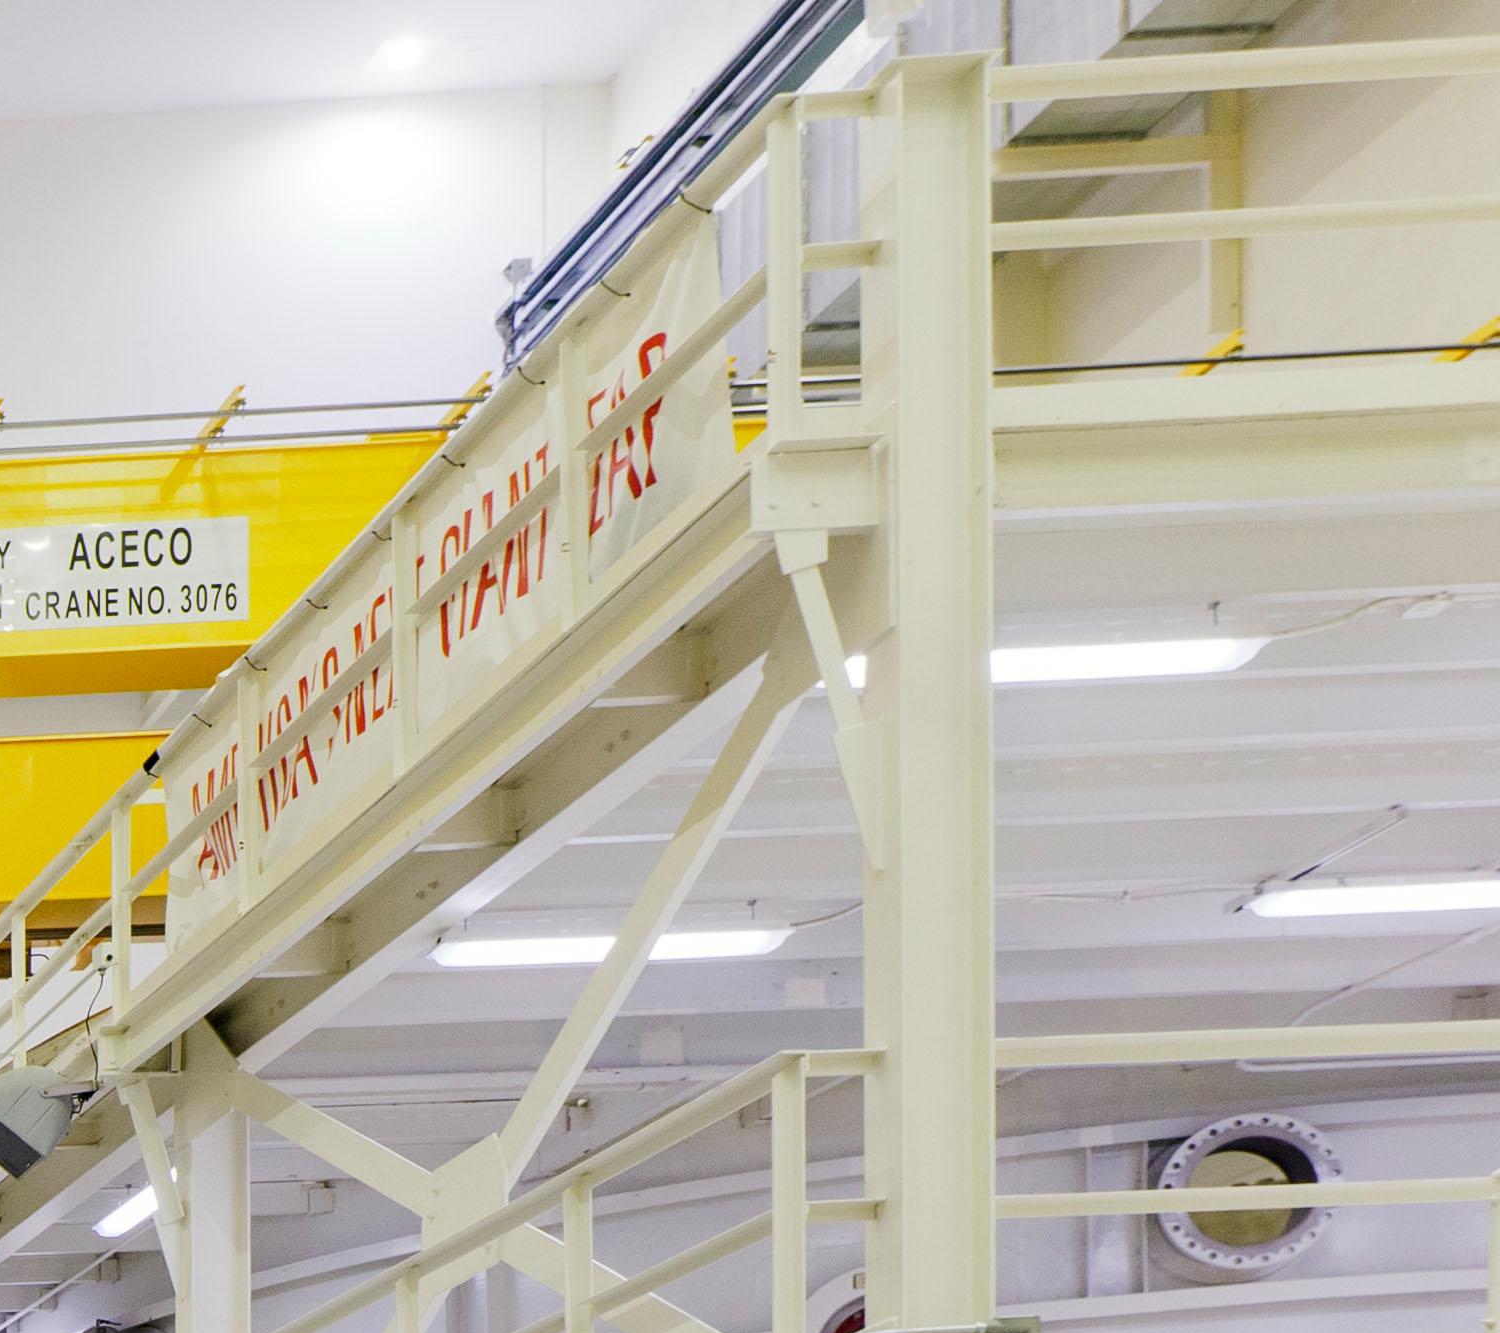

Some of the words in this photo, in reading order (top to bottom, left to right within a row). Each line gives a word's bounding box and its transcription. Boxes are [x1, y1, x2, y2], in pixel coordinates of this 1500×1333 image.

[69, 527, 192, 570] ACECO
[25, 589, 121, 621] CRANE
[127, 587, 171, 615] NO.
[180, 583, 237, 613] 3076
